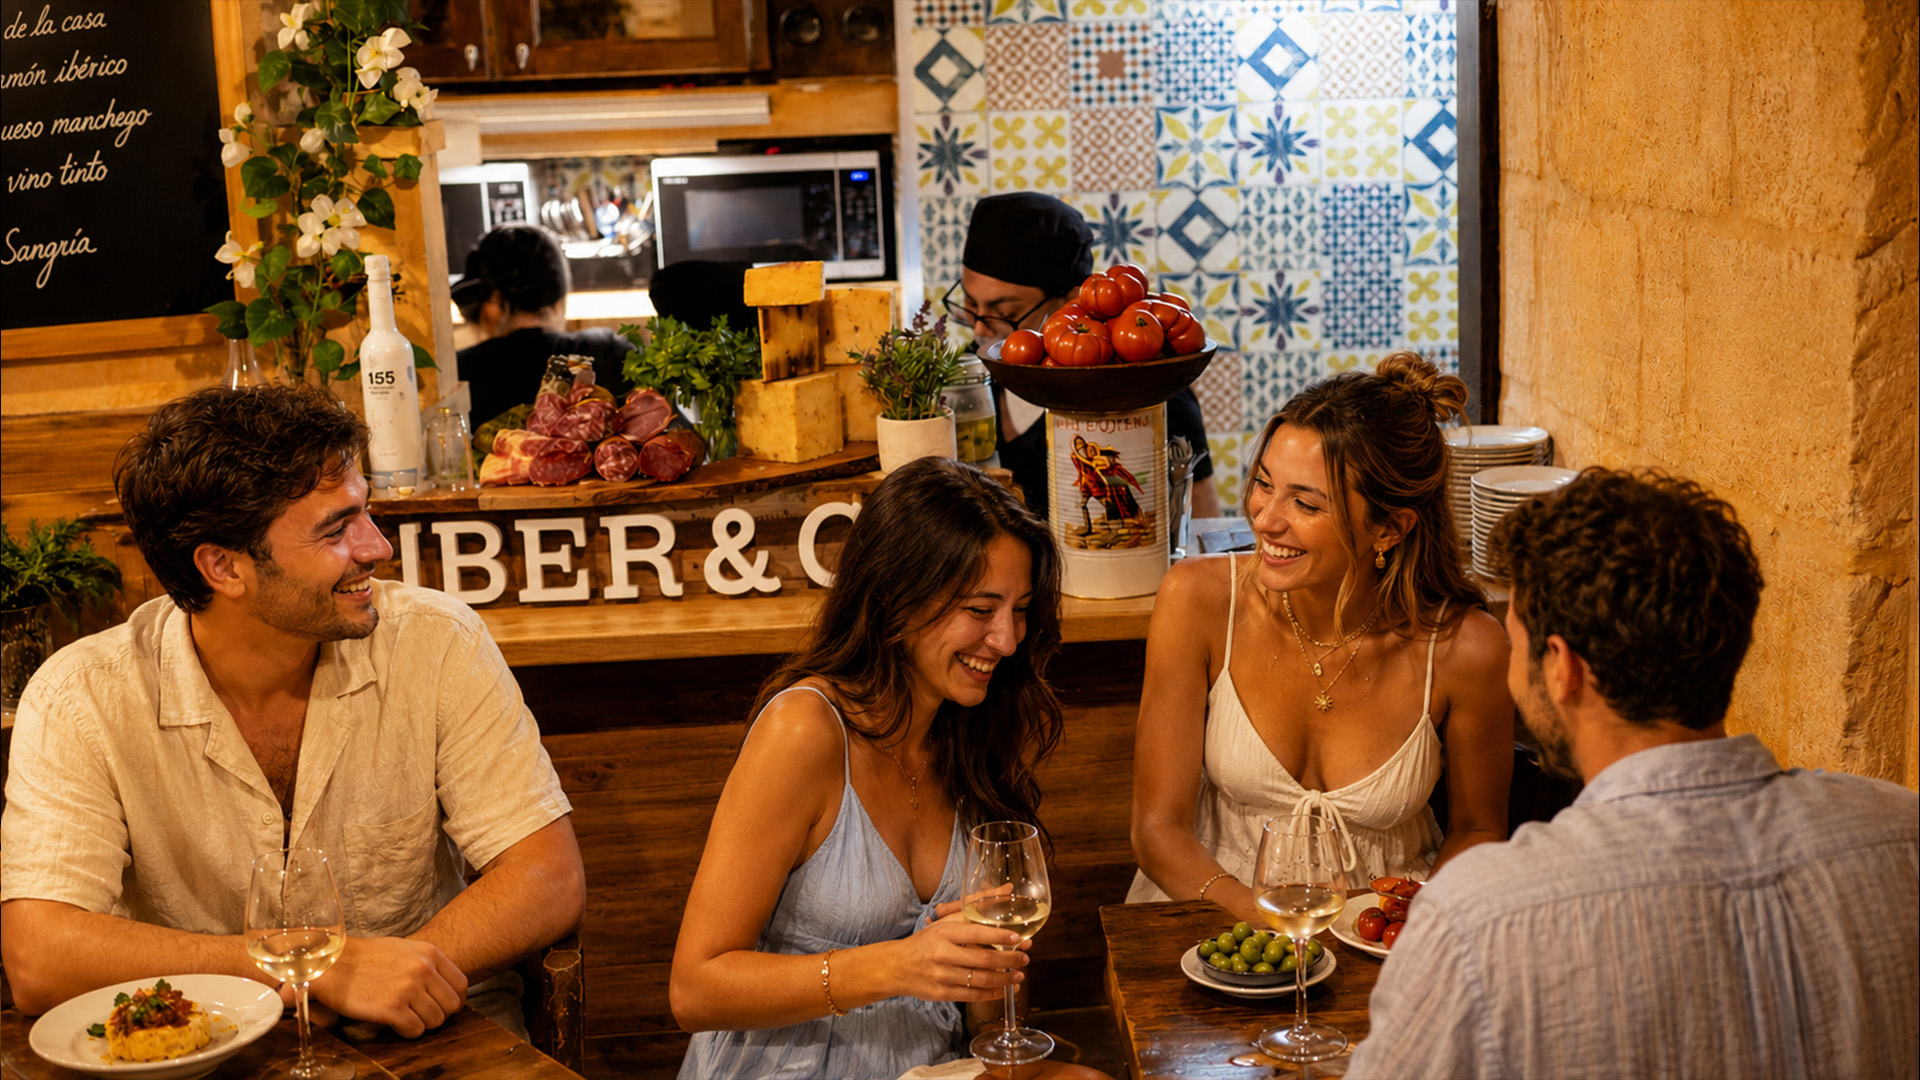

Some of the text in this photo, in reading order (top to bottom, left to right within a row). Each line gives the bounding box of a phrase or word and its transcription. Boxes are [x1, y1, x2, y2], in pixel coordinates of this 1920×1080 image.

[4, 4, 107, 40] de la casa
[53, 49, 128, 83] ibérico
[50, 98, 152, 148] manchego
[7, 150, 108, 193] vino tinto
[1, 227, 97, 289] Sangría
[368, 370, 396, 385] 155
